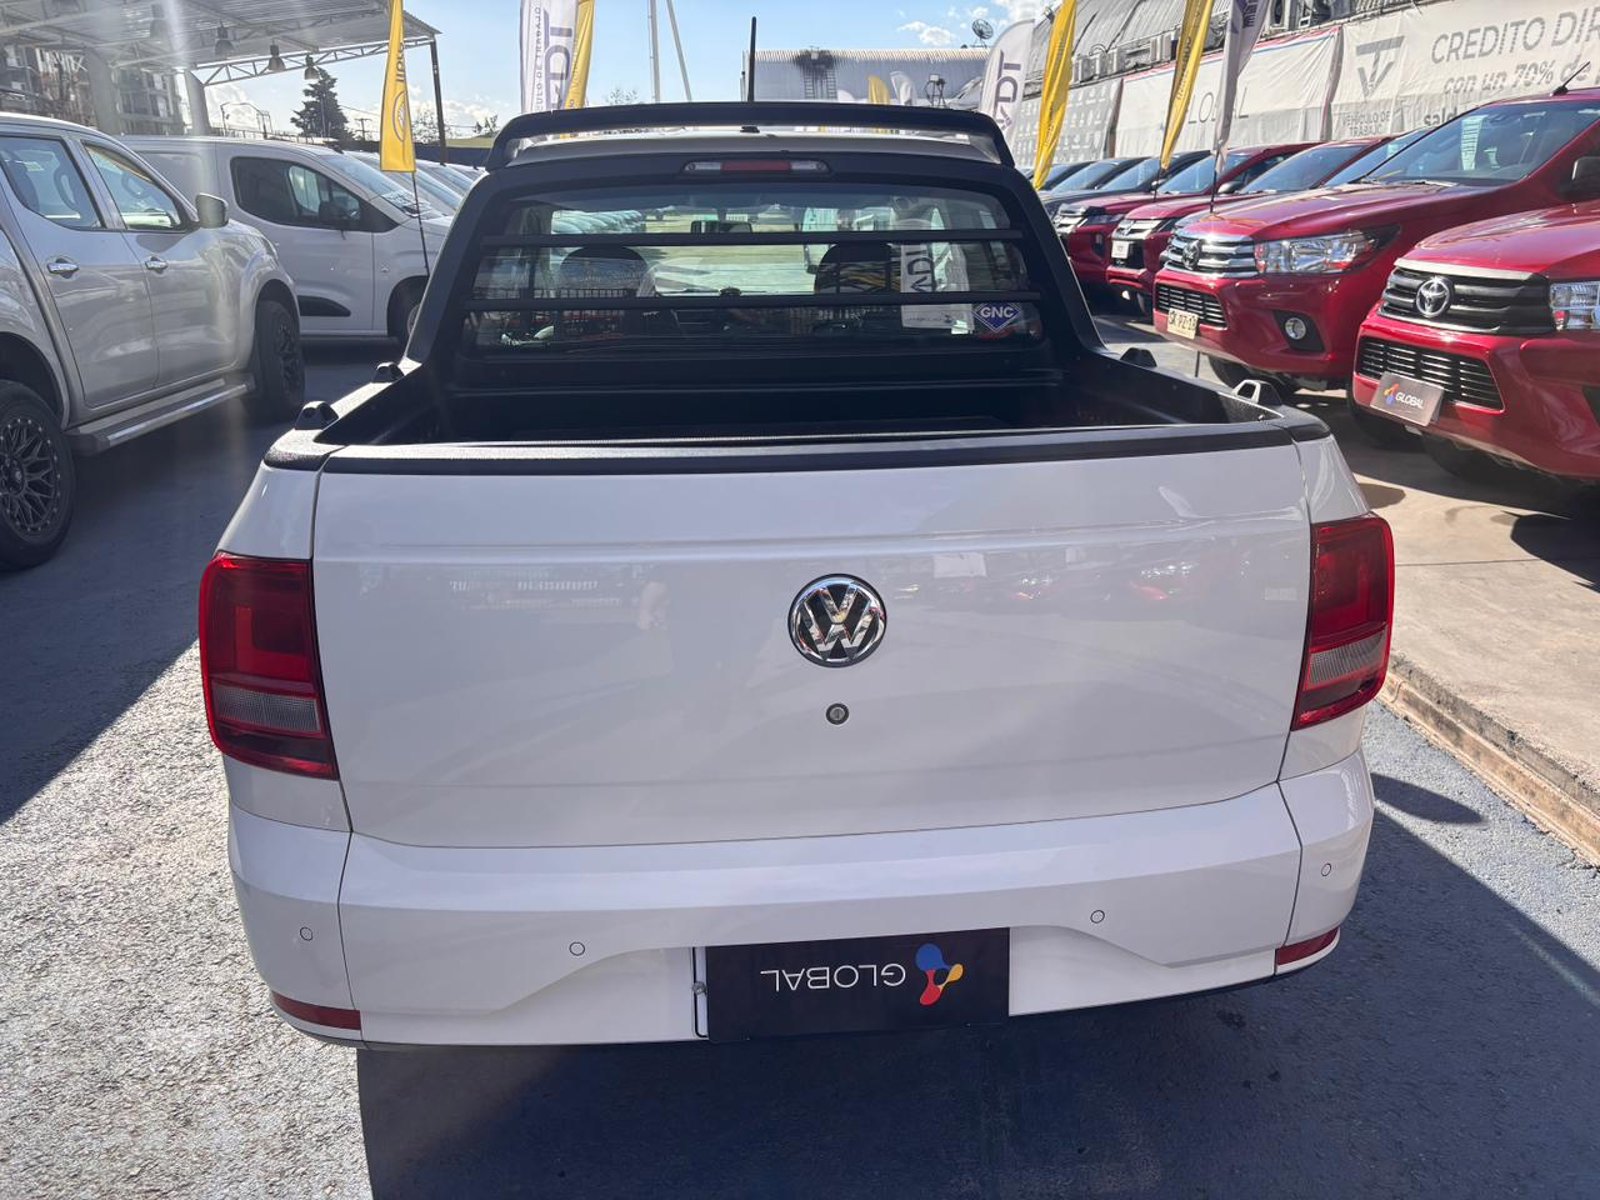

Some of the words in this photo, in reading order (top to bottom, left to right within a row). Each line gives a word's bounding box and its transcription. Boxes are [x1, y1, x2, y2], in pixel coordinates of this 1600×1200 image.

[1431, 17, 1546, 64] CREDITO
[1444, 73, 1478, 95] con
[1481, 71, 1508, 92] un
[979, 306, 1014, 318] GNC
[1395, 392, 1425, 409] GLOBAL
[760, 963, 906, 992] GLOBAL
